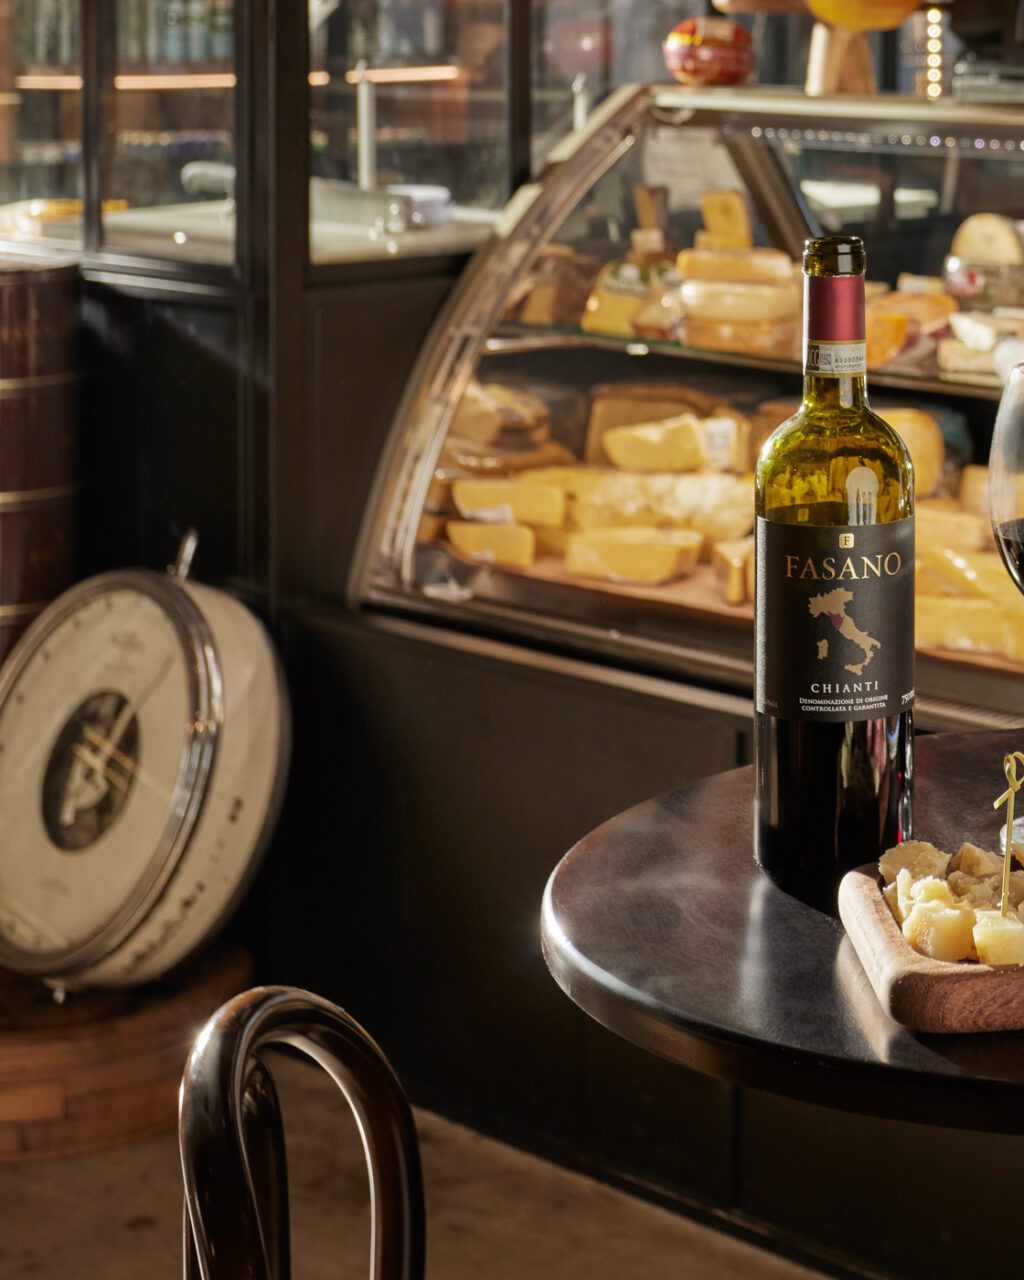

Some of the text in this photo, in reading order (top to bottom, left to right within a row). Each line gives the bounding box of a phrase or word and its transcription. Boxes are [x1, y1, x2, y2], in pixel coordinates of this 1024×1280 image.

[784, 552, 902, 580] FASANO
[811, 681, 879, 693] CHIANTI
[799, 697, 854, 705] DENOMINAZIONE
[864, 694, 888, 703] ORIGINE
[853, 702, 886, 711] GARANTITA
